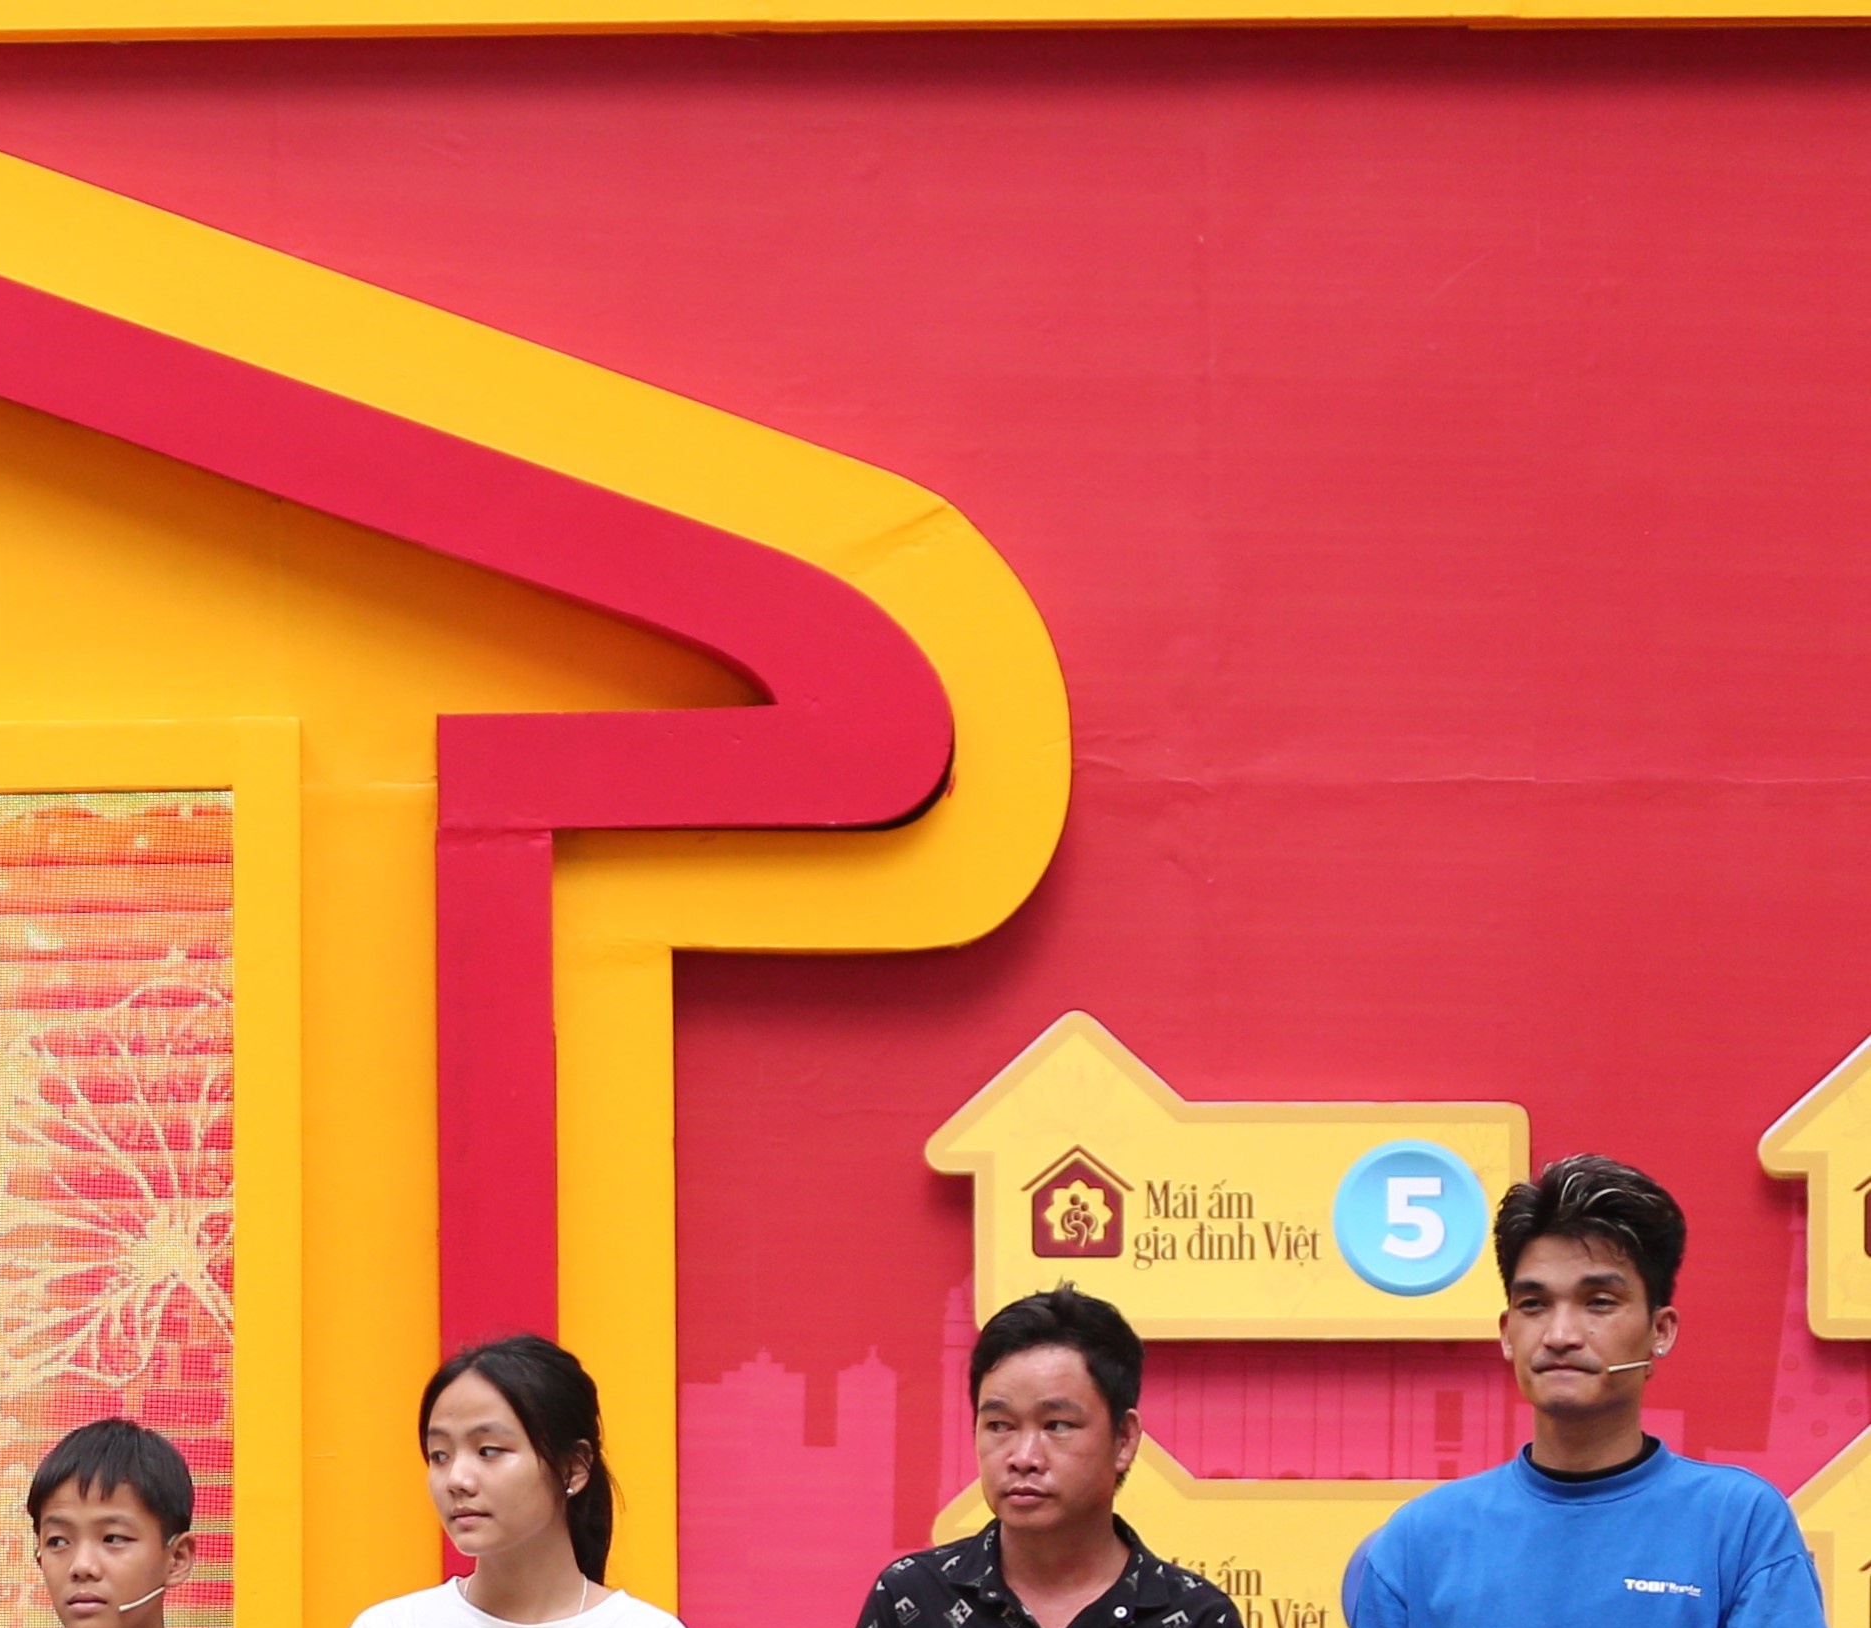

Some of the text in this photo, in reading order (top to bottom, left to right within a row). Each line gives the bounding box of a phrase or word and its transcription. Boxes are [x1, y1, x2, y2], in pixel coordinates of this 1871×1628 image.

[1144, 1178, 1255, 1219] Mái ấm
[1381, 1176, 1446, 1259] 5
[1133, 1221, 1323, 1271] gia đình Việt
